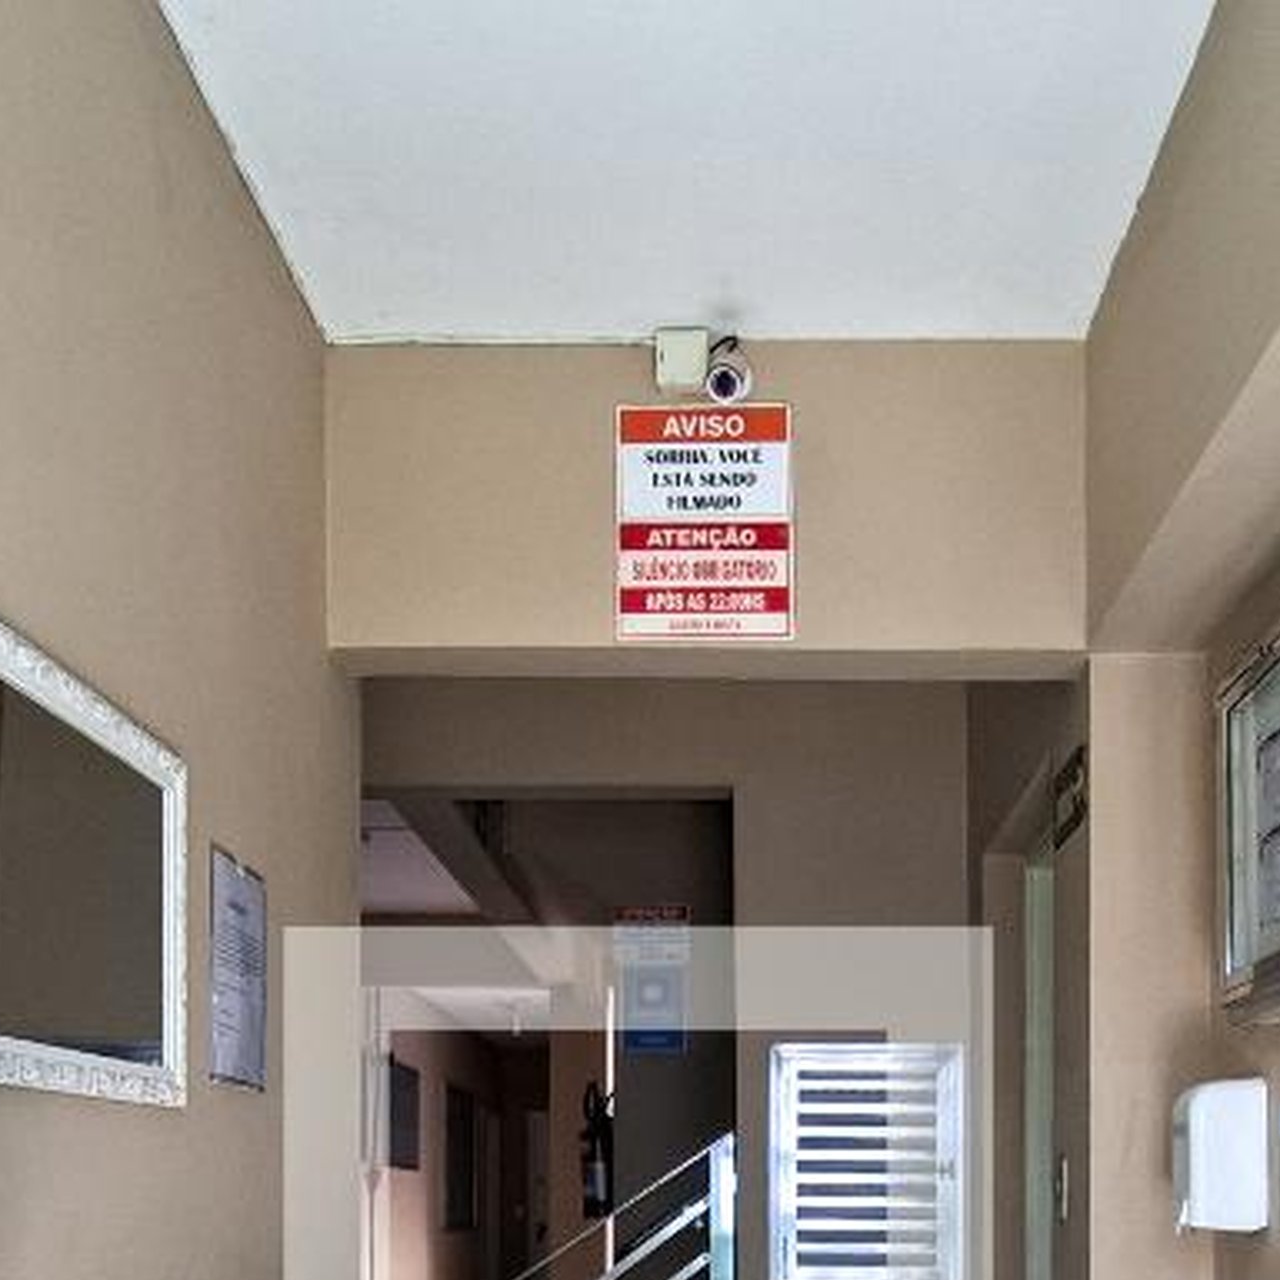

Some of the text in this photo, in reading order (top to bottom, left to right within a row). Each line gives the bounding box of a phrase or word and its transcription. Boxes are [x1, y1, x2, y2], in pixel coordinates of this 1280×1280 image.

[662, 414, 745, 438] AVISO
[699, 472, 757, 488] SENDO
[666, 494, 742, 510] FILMADO
[646, 526, 758, 551] ATENÇÃO
